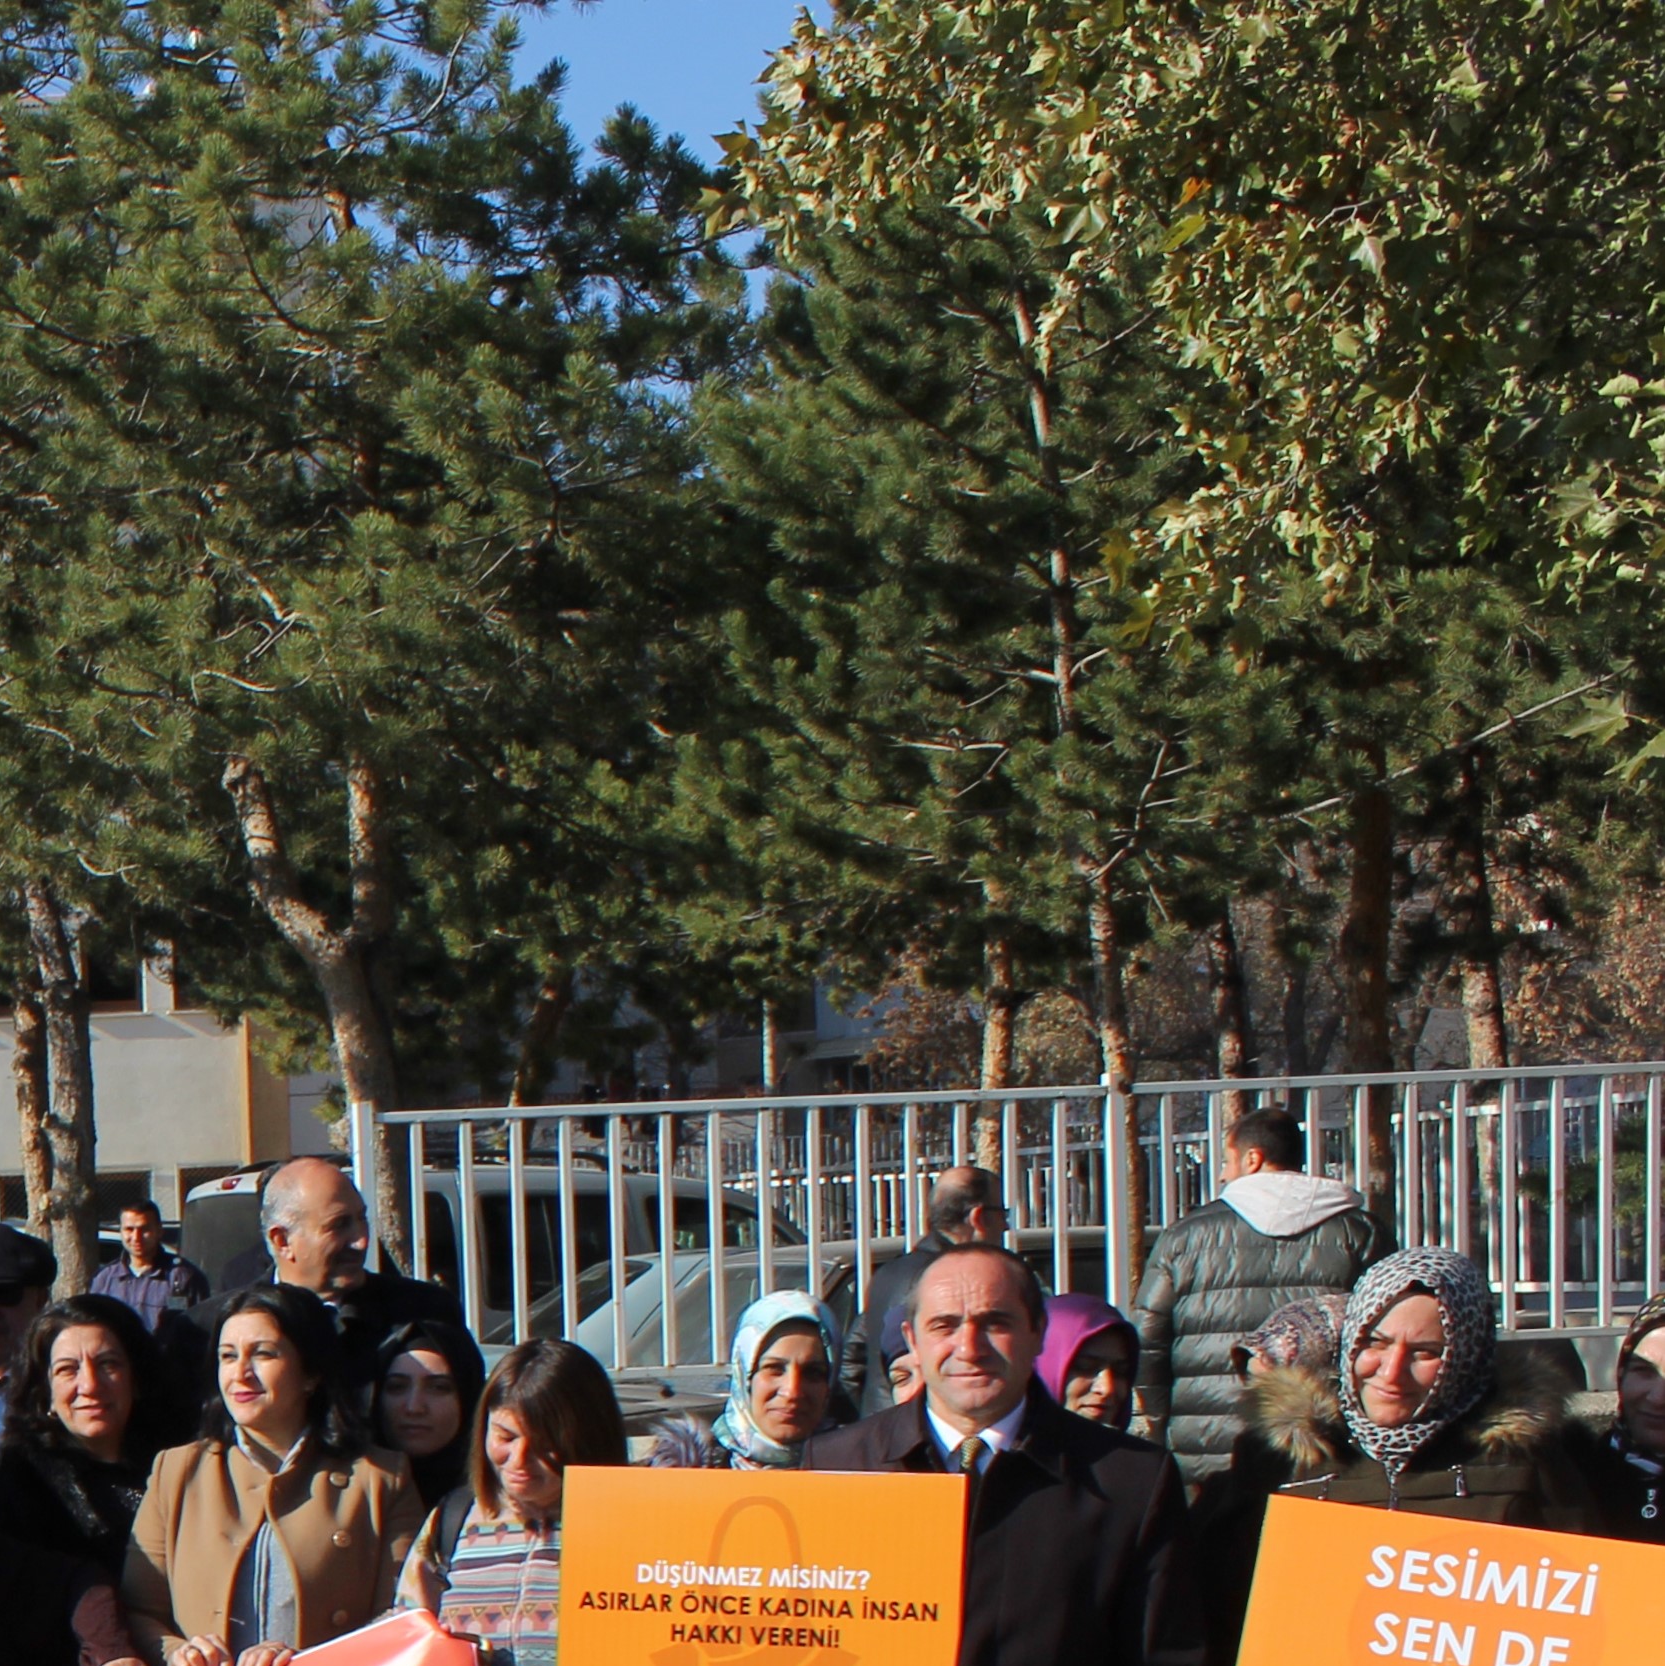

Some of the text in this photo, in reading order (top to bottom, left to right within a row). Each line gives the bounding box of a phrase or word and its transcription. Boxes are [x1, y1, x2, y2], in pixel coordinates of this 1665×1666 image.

[636, 1560, 870, 1590] DÜŞÜNMEZ MİSİNİZ?
[1365, 1545, 1599, 1616] SESİMİZİ
[579, 1590, 939, 1621] ASIRLAR ÖNCE KADINA İNSAN
[670, 1624, 840, 1649] HAKKI VERENİ!
[1369, 1612, 1476, 1666] SEN
